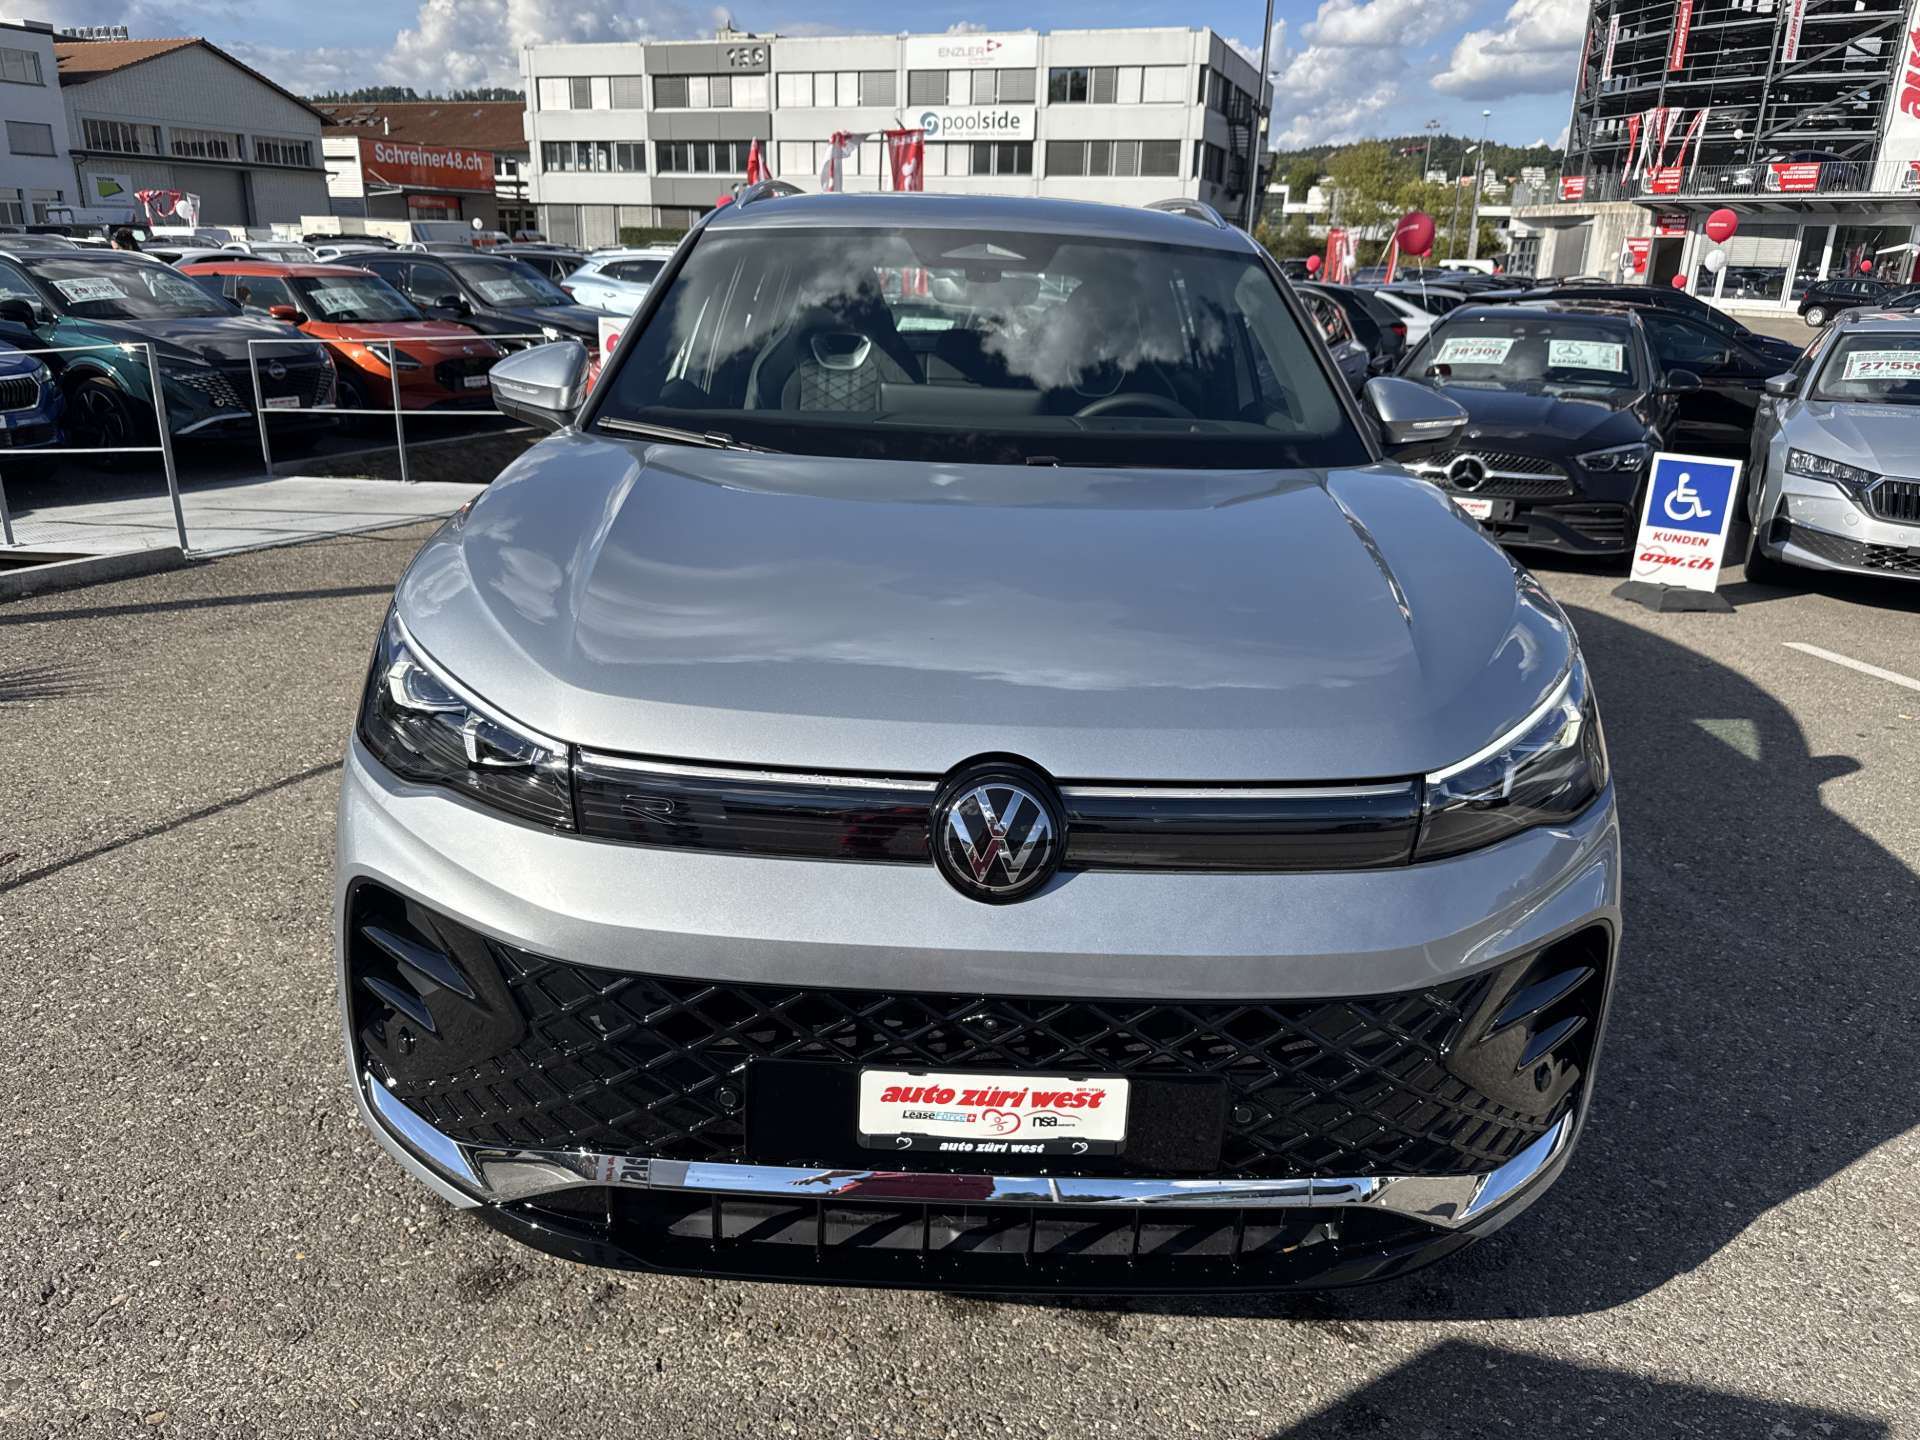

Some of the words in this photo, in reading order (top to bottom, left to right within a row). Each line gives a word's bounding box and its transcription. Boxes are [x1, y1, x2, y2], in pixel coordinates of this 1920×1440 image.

[938, 46, 985, 58] ENZLER
[942, 110, 1021, 137] poolside
[375, 143, 483, 171] Schreiner48.ch
[1653, 531, 1710, 547] KUNDEN
[1639, 552, 1715, 570] azw.ch
[880, 1084, 956, 1105] auto
[956, 1086, 1029, 1108] züri
[1031, 1088, 1107, 1109] west
[902, 1110, 967, 1123] LeaseForce
[1032, 1116, 1058, 1127] nsa
[939, 1142, 974, 1151] auto
[975, 1142, 1009, 1153] züri
[1011, 1143, 1046, 1153] west
